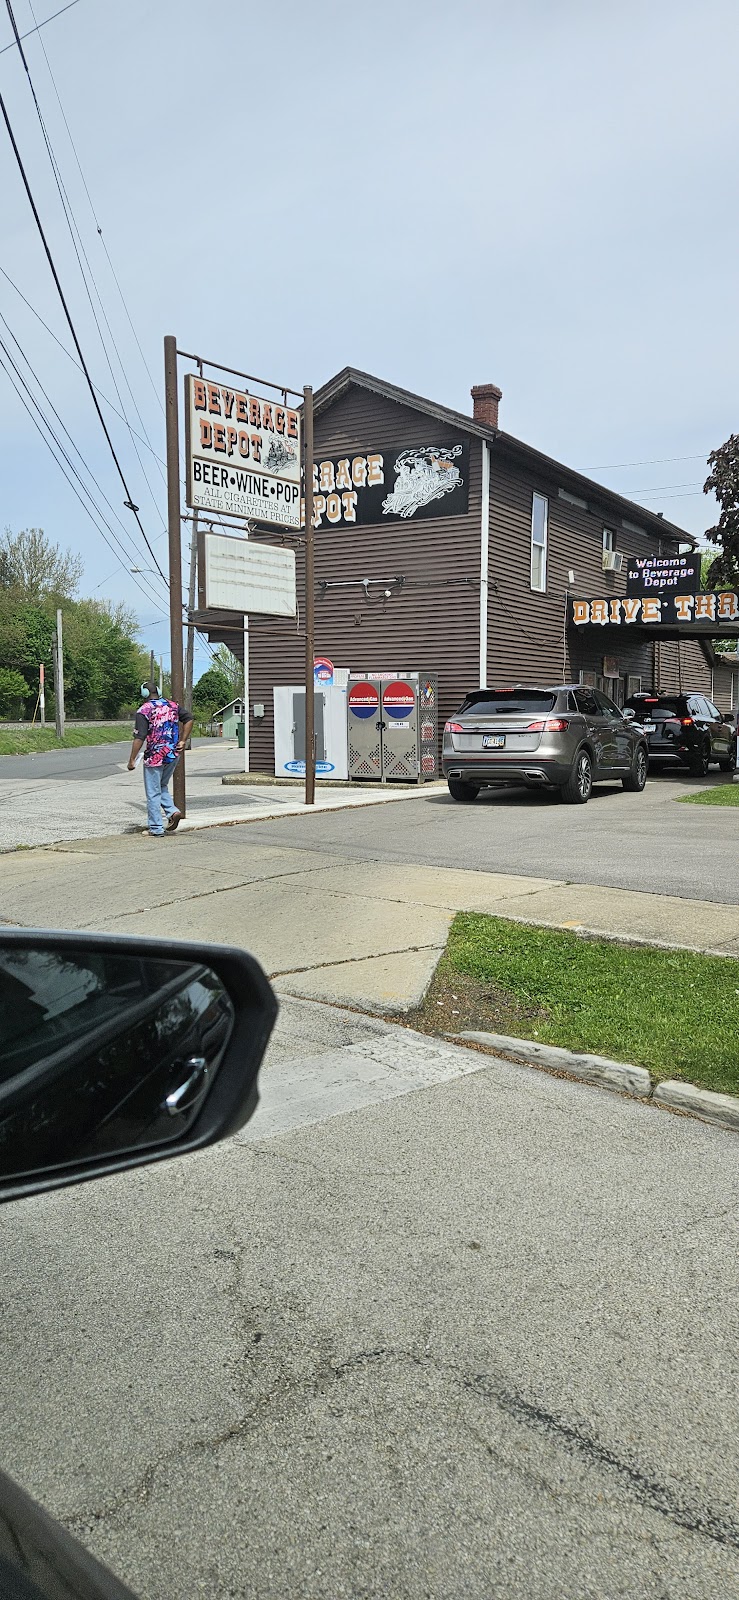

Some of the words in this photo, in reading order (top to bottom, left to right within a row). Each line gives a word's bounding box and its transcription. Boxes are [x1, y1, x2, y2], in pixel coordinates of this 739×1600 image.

[193, 379, 298, 440] BEVERAGE
[199, 418, 262, 464] DEPOT
[194, 495, 224, 510] STATE
[225, 501, 268, 518] MINIMUM
[270, 512, 300, 526] PRICES
[204, 487, 222, 499] ALL
[223, 491, 279, 511] CIGARETTES
[281, 504, 291, 514] AT
[629, 571, 639, 579] to
[642, 568, 695, 579] Beverage
[636, 557, 687, 568] Welcome
[645, 576, 678, 587] Depot
